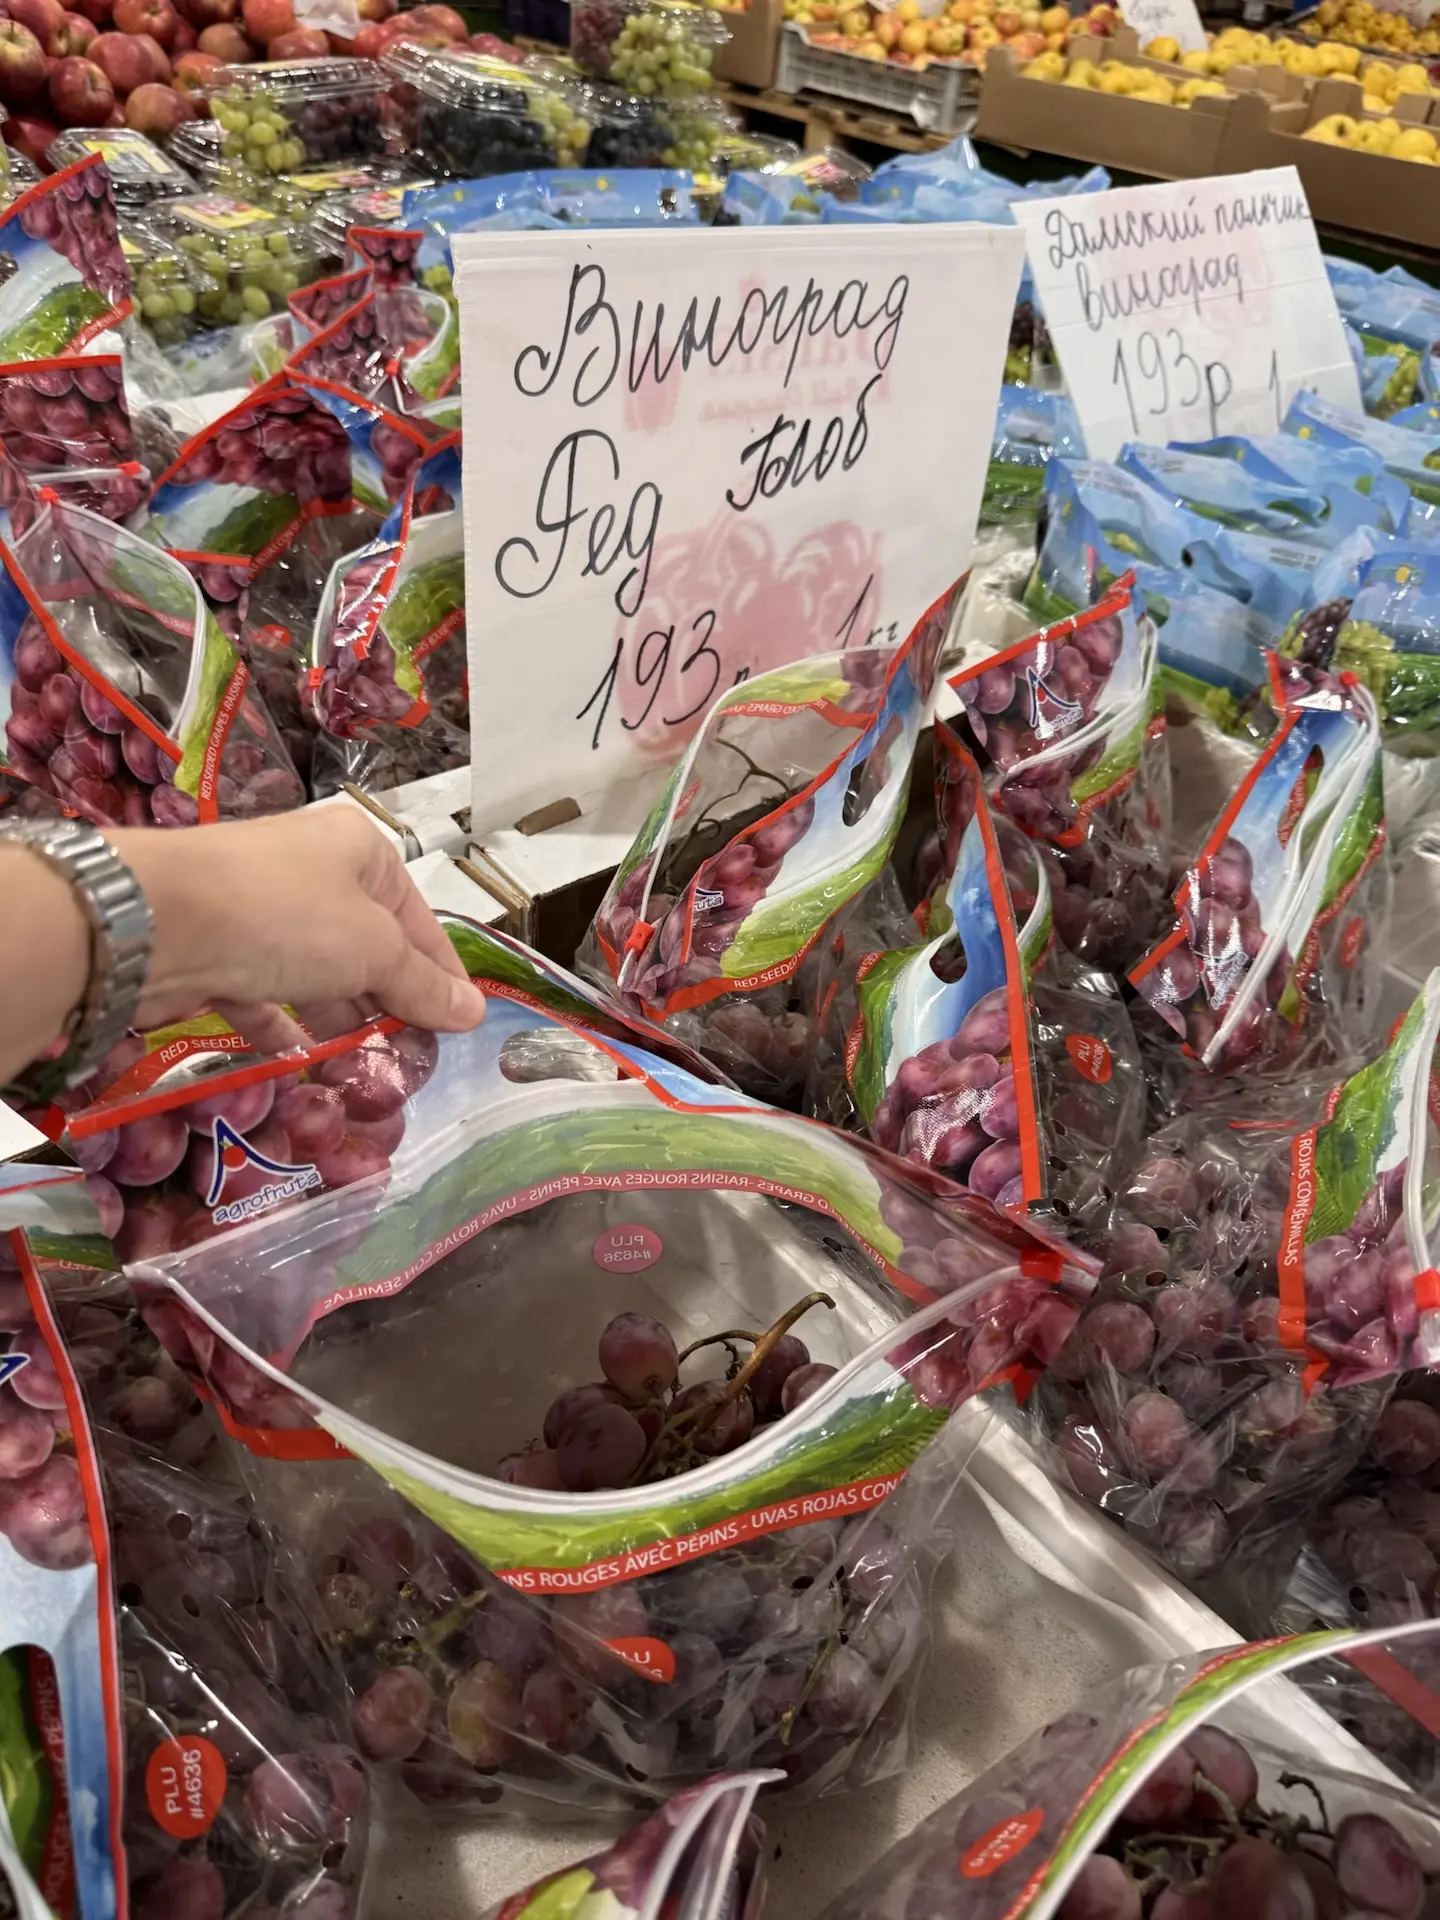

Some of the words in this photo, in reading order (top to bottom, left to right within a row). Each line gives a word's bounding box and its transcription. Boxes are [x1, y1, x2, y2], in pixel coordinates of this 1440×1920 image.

[513, 263, 910, 408] Виноград
[212, 712, 230, 748] GRAPES
[203, 747, 218, 780] SEEDED
[201, 776, 213, 801] RED
[733, 976, 759, 988] RED
[159, 1040, 189, 1064] RED
[1077, 1040, 1091, 1062] PLU
[1298, 1138, 1313, 1180] ROJAS
[213, 1172, 322, 1223] agrofruta
[539, 1562, 621, 1588] ROUGES
[751, 1503, 799, 1530] UVAS
[802, 1488, 858, 1517] ROJAS
[160, 1766, 183, 1815] PLU
[182, 1748, 206, 1820] #4636
